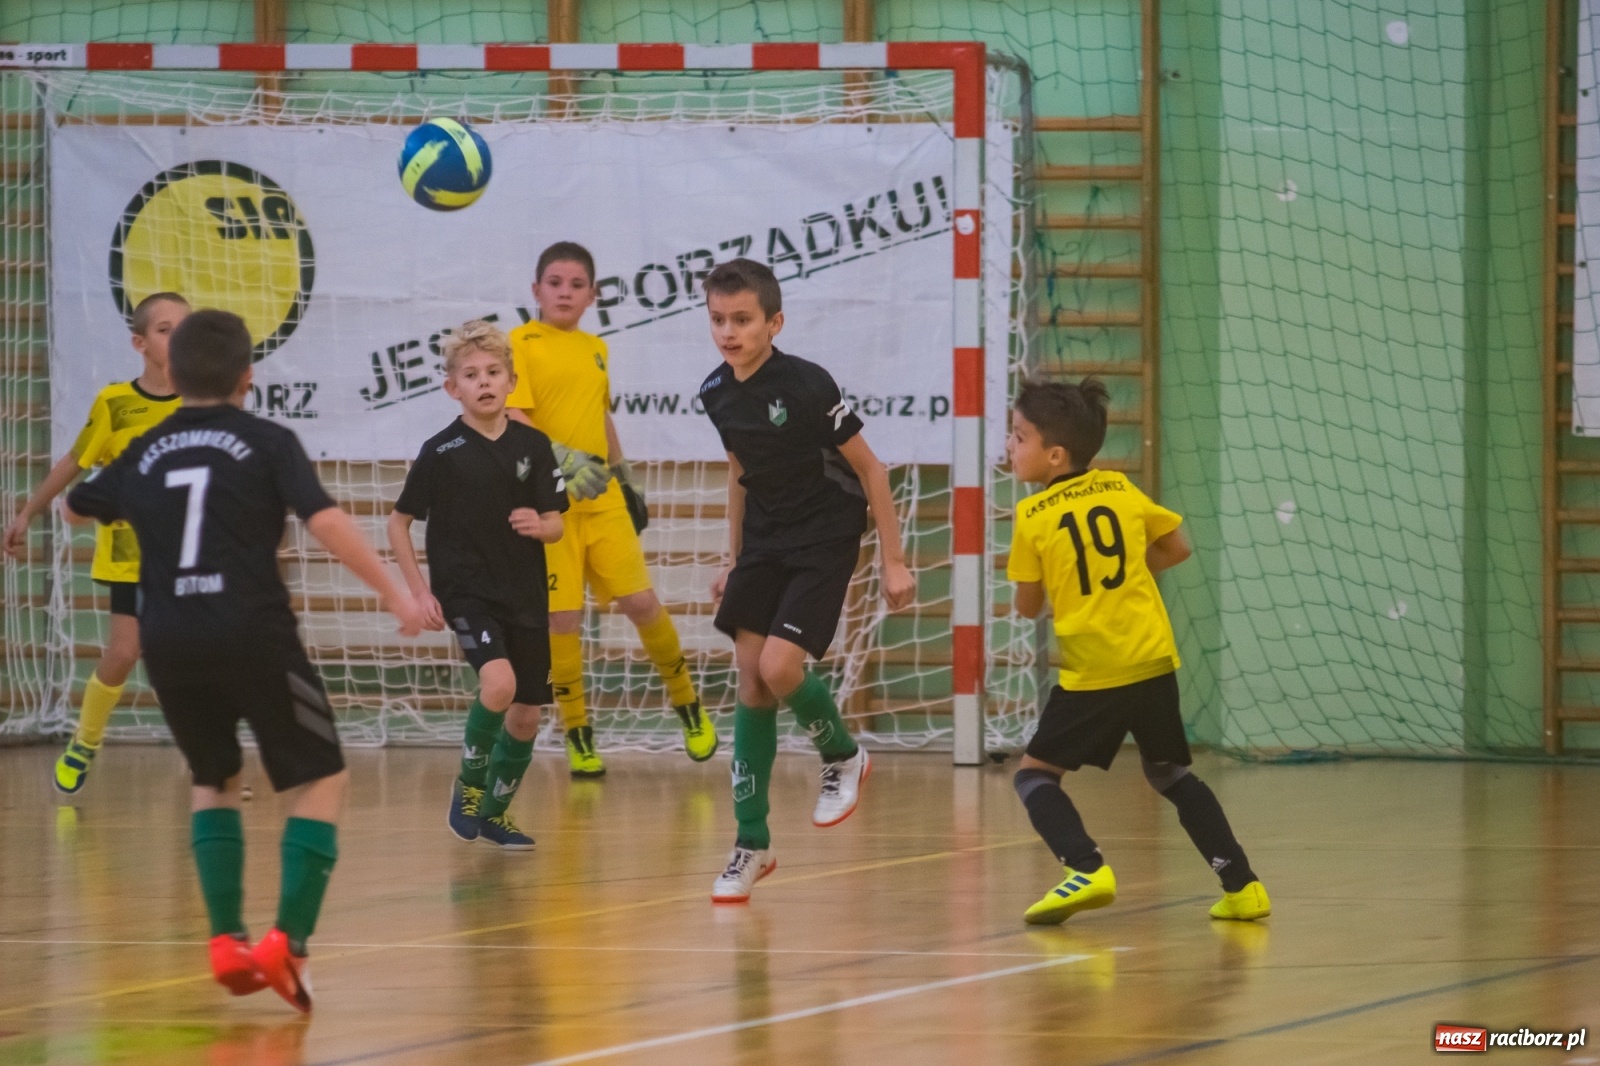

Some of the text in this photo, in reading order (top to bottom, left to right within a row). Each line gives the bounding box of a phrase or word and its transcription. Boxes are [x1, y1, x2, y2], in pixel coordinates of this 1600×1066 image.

[26, 49, 67, 65] sport
[164, 465, 211, 570] 7
[1058, 505, 1127, 597] 19
[481, 630, 491, 644] 4
